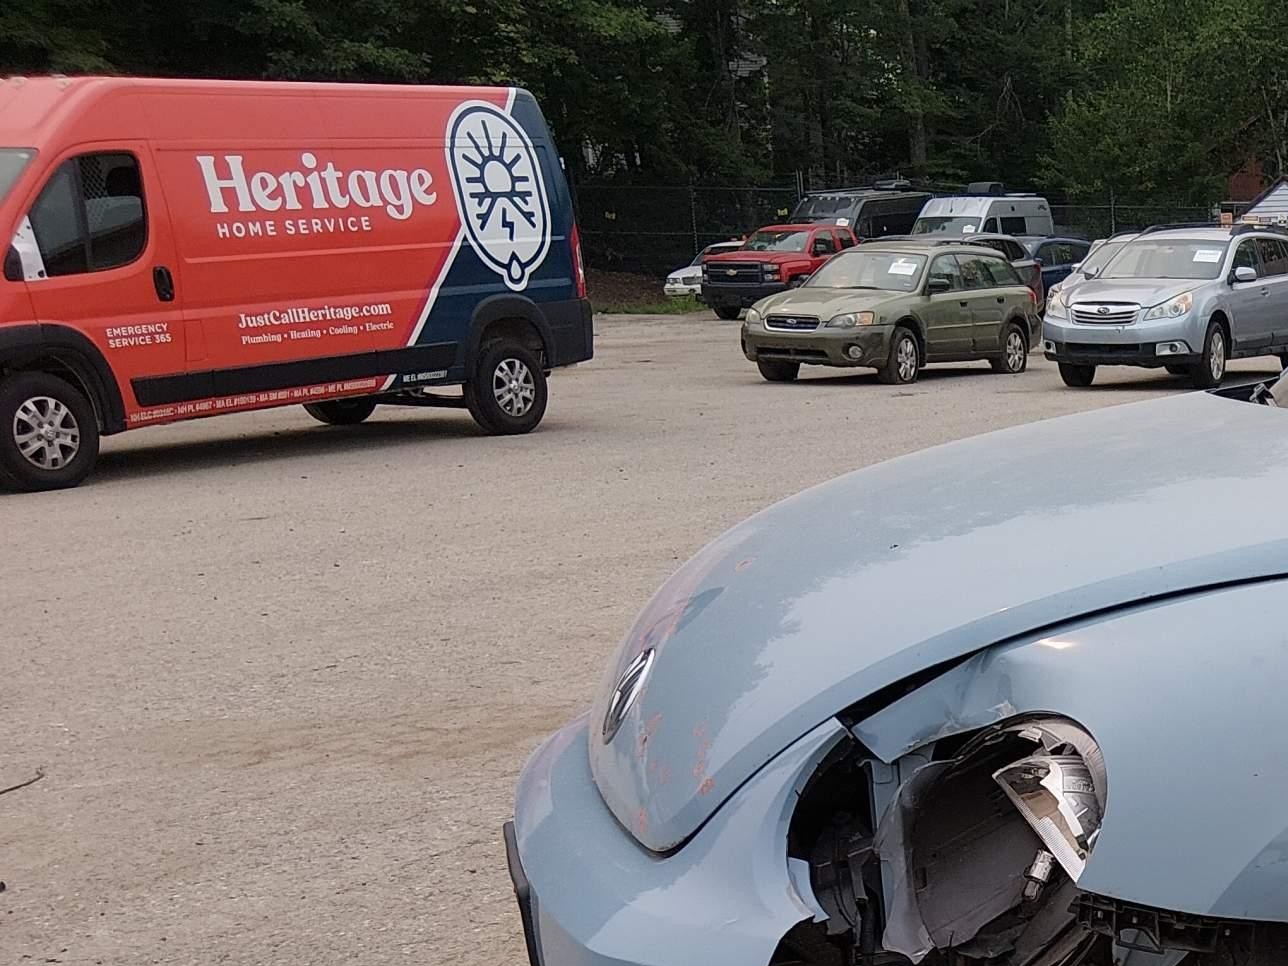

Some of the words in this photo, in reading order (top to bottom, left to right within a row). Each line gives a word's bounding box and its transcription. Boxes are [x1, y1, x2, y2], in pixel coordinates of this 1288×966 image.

[196, 152, 437, 220] Heritage
[217, 220, 278, 239] HOME
[285, 216, 373, 235] SERVICE
[238, 303, 391, 328] JustCallHeritage.com
[106, 323, 168, 337] EMERGENCY
[109, 335, 152, 348] SERVICE
[154, 333, 172, 344] 365
[241, 333, 282, 345] Plumbing
[290, 328, 321, 340] Heating
[329, 324, 358, 336] Cooling
[365, 320, 394, 332] Electric
